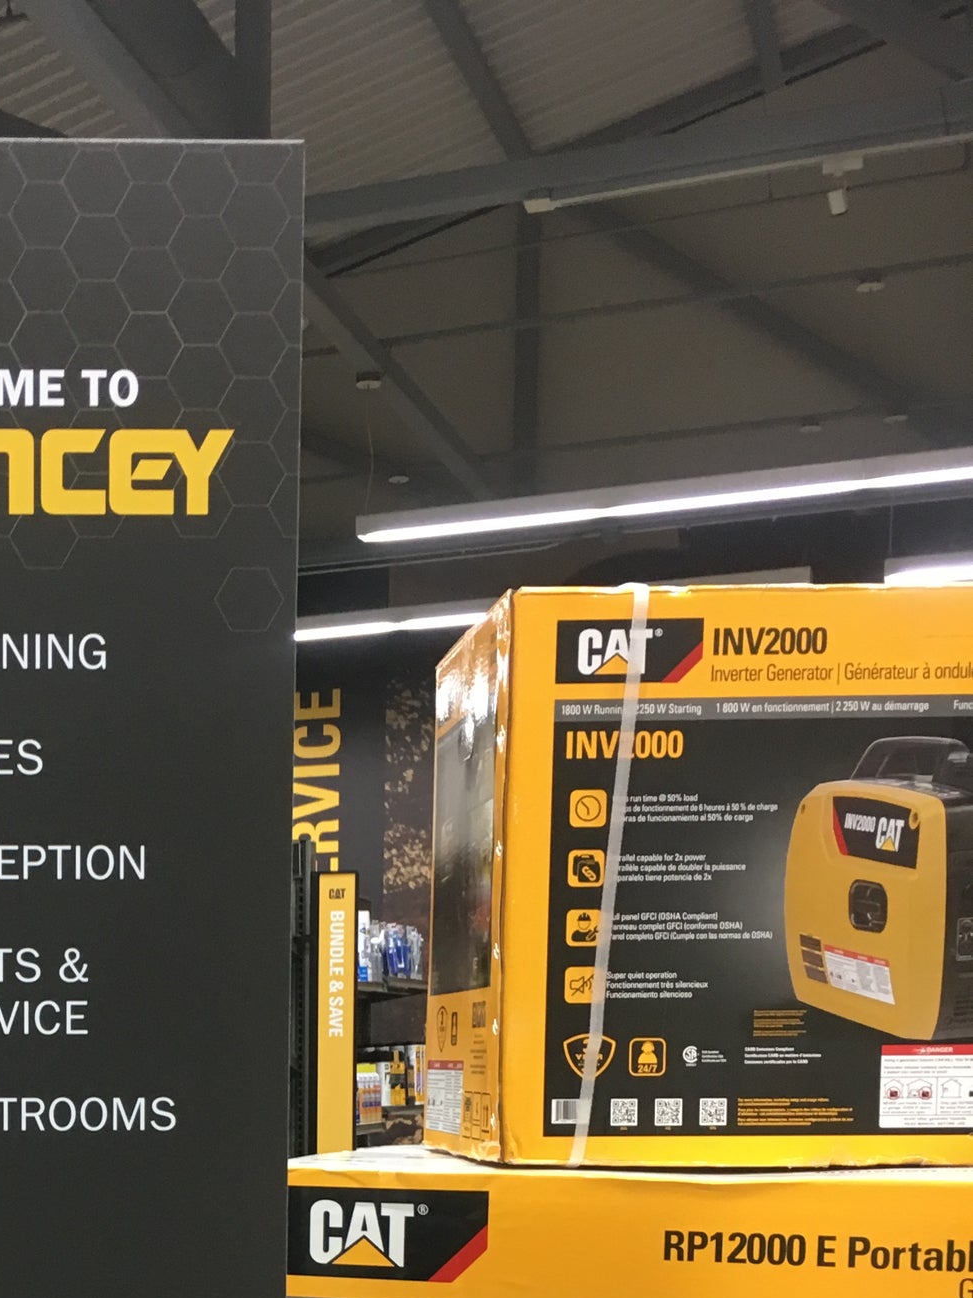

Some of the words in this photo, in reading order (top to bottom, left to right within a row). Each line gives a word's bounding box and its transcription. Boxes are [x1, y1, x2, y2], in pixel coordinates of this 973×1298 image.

[81, 368, 139, 407] TO
[712, 627, 827, 656] INV2000
[710, 665, 763, 682] Inverter
[766, 663, 833, 682] Generator
[844, 662, 919, 681] Générateur
[922, 661, 931, 680] à
[934, 660, 973, 680] ondul
[561, 704, 580, 716] 1800
[582, 704, 593, 715] W
[594, 703, 624, 716] Runnin
[656, 703, 667, 714] W
[668, 703, 702, 716] Starting
[740, 702, 751, 713] W
[752, 704, 763, 713] en
[764, 702, 829, 713] fonctionnement
[860, 701, 871, 712] W
[872, 703, 883, 712] au
[884, 700, 930, 713] démarrage
[565, 730, 684, 759] INV000
[292, 688, 341, 871] RVICE
[844, 813, 877, 833] INV2000
[875, 817, 905, 852] CAT
[328, 888, 346, 899] CAT
[329, 910, 345, 977] BUNDLE
[58, 948, 89, 983] &
[329, 979, 344, 993] &
[328, 996, 344, 1038] SAVE
[637, 1064, 658, 1073] 24/7
[309, 1199, 415, 1267] CAT
[663, 1230, 806, 1266] RP12000
[816, 1235, 837, 1267] E
